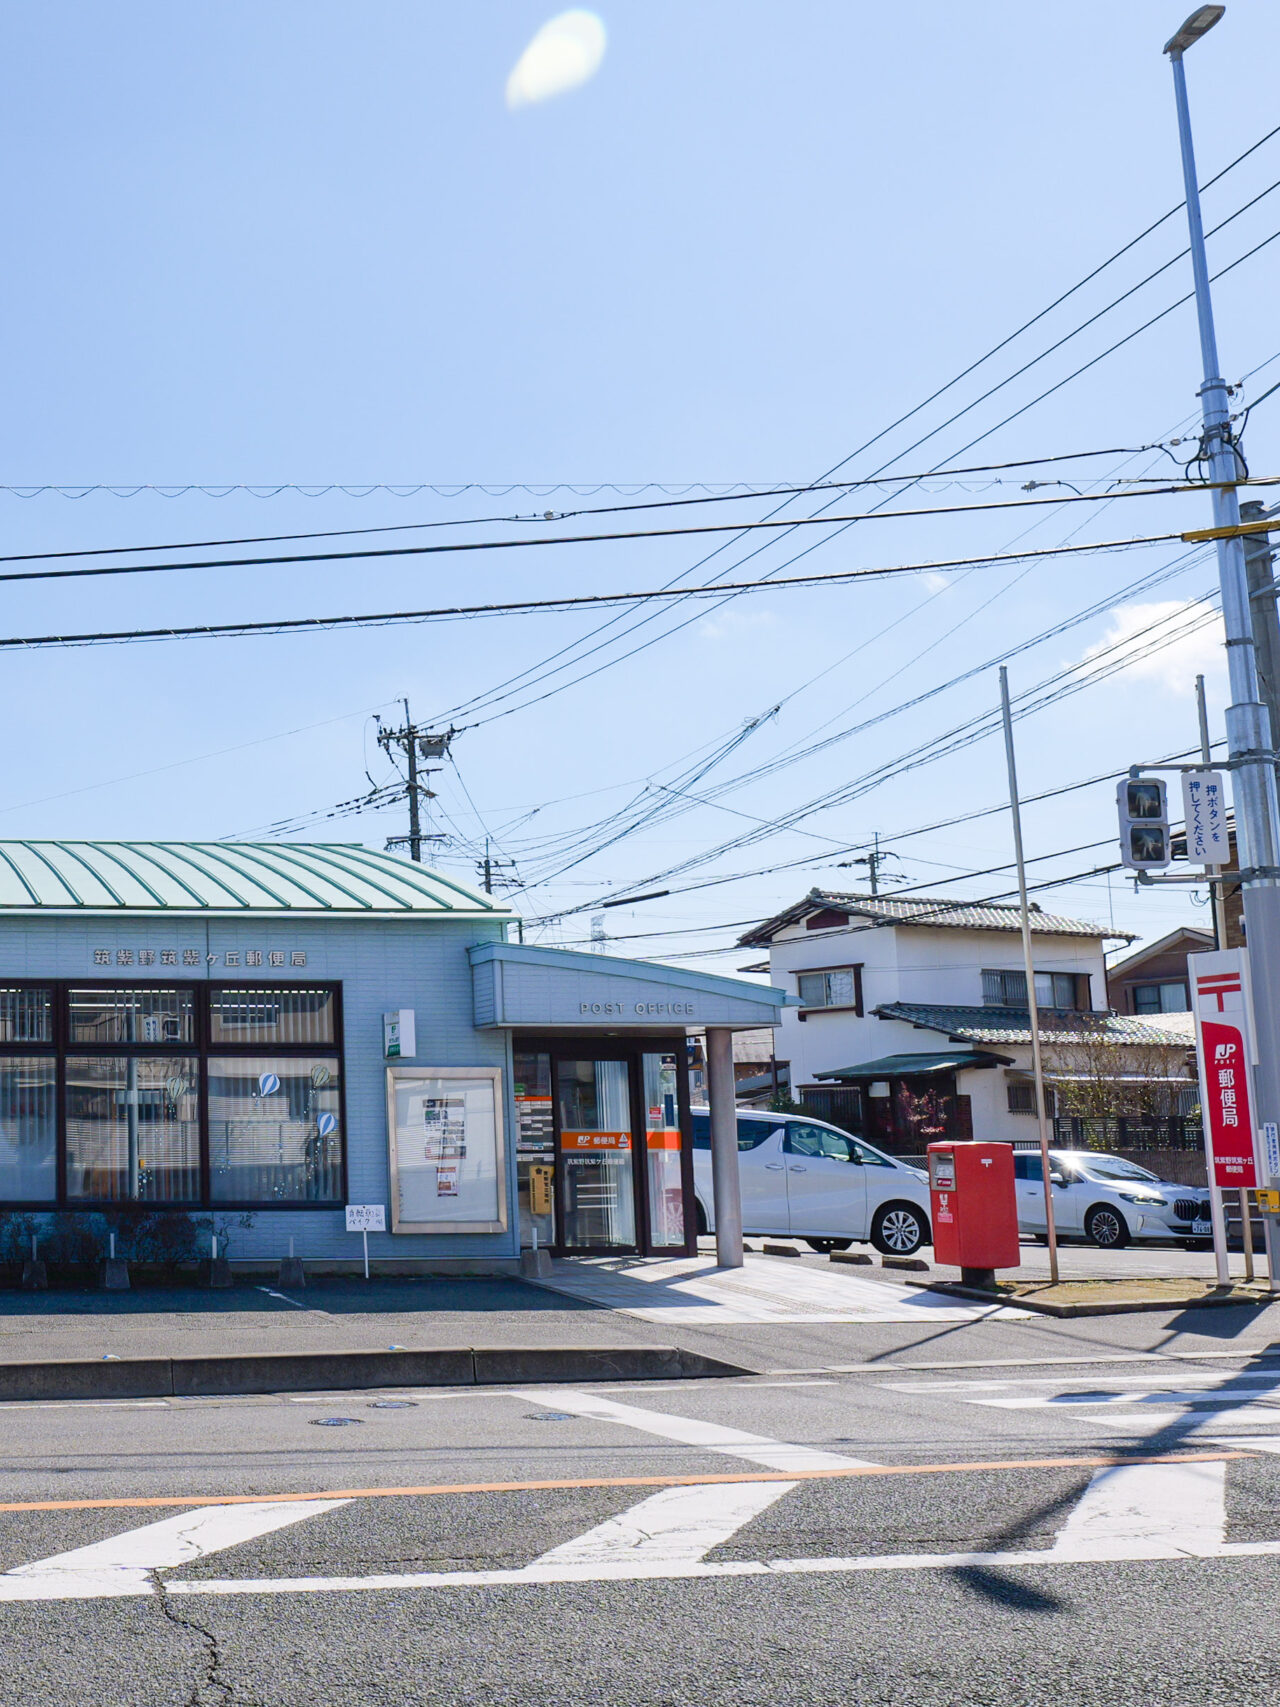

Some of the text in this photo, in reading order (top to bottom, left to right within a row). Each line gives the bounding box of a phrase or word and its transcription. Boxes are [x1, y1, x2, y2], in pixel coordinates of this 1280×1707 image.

[1189, 781, 1206, 856] 押してください
[1205, 785, 1220, 842] 押ボタンを
[579, 1002, 695, 1015] POST OFFICE
[1215, 1043, 1236, 1059] JP
[1218, 1068, 1237, 1128] 郵便局
